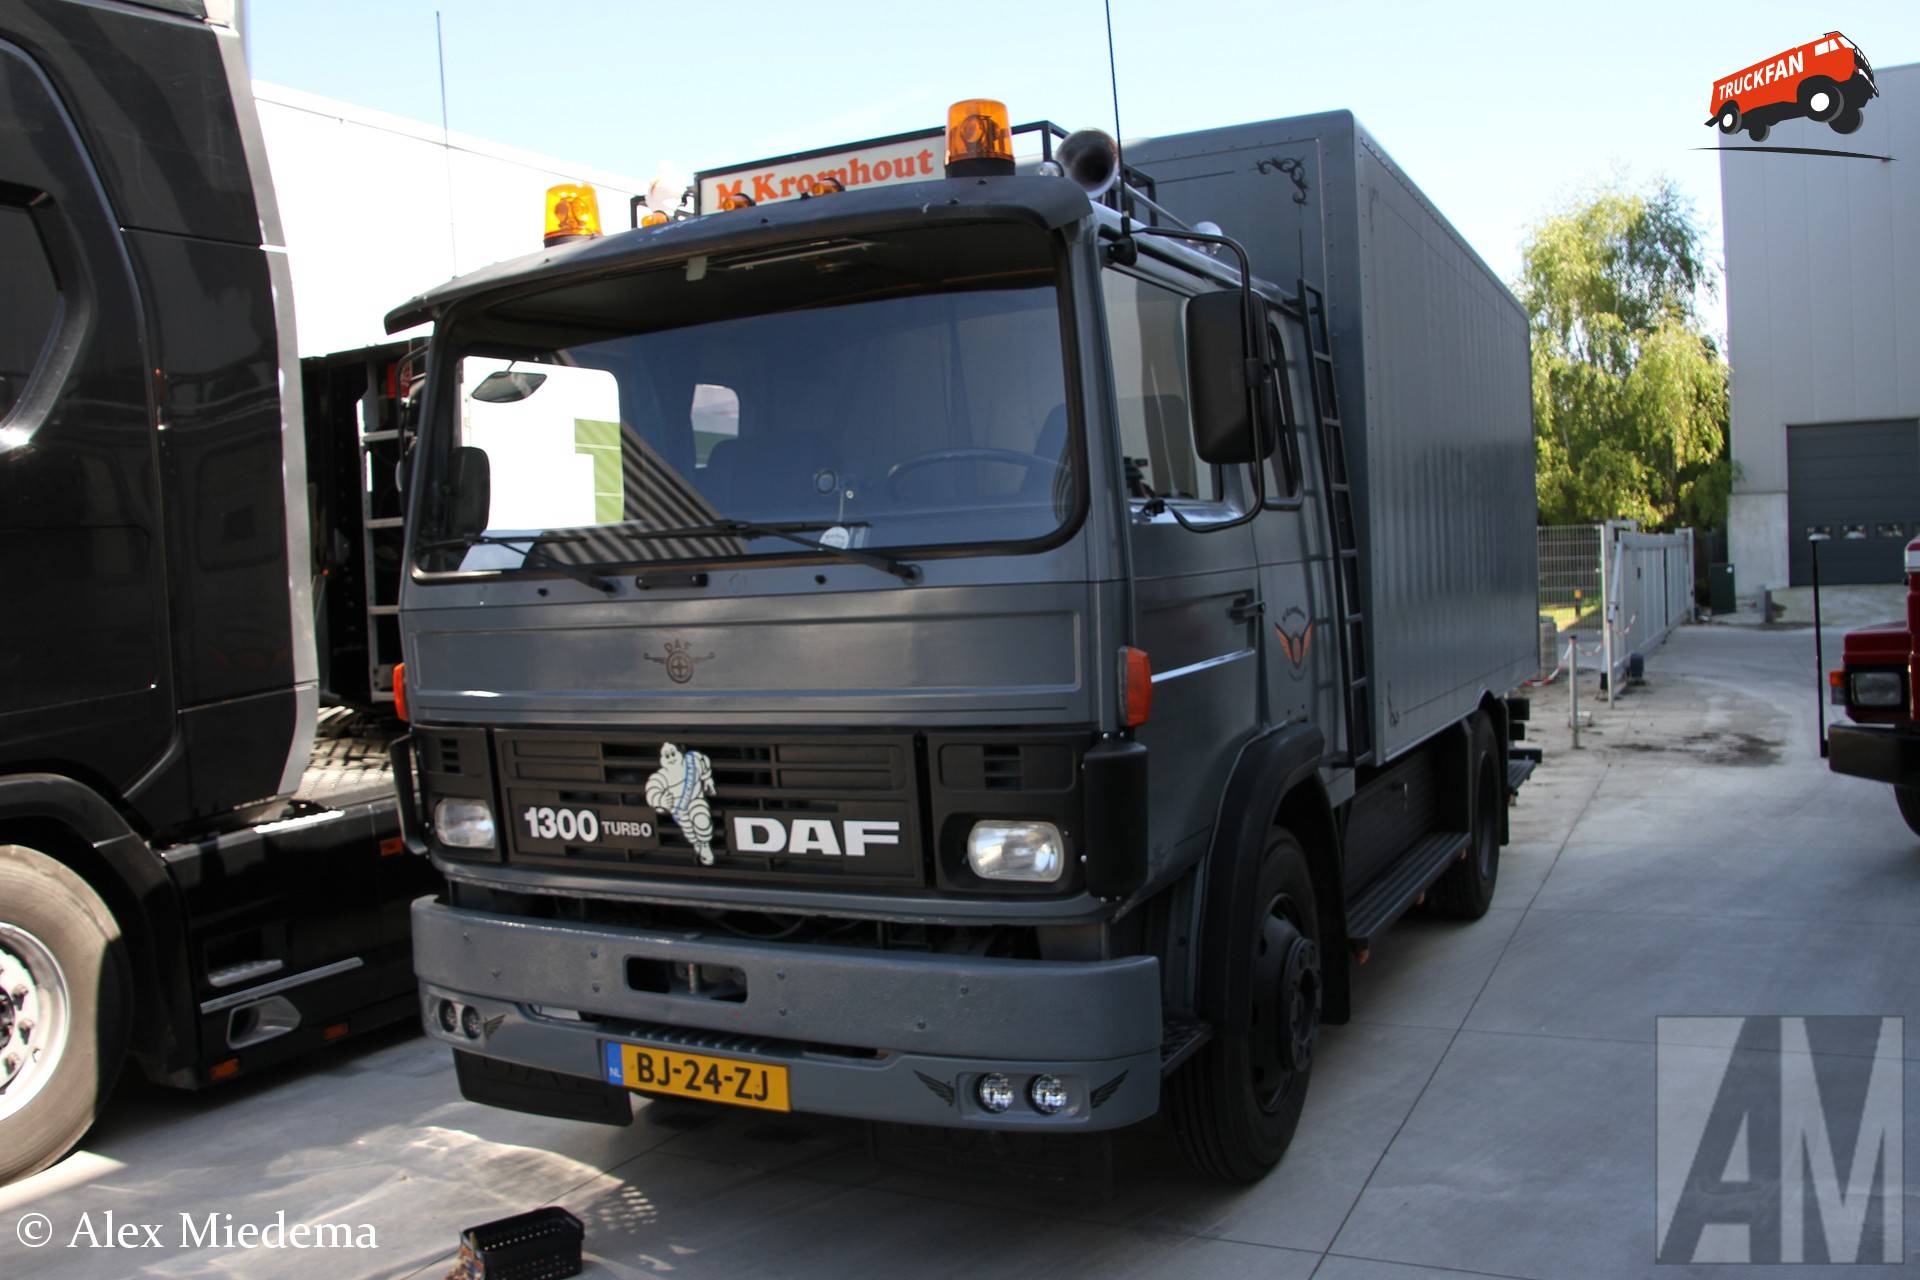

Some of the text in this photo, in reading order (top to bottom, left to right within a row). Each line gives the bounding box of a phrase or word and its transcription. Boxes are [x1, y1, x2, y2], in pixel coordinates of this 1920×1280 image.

[751, 149, 934, 203] Kromhout
[523, 806, 652, 842] 1300 TURBO
[733, 816, 900, 857] DAF
[608, 1067, 622, 1079] NL
[636, 1052, 769, 1102] BJ-24-ZJ
